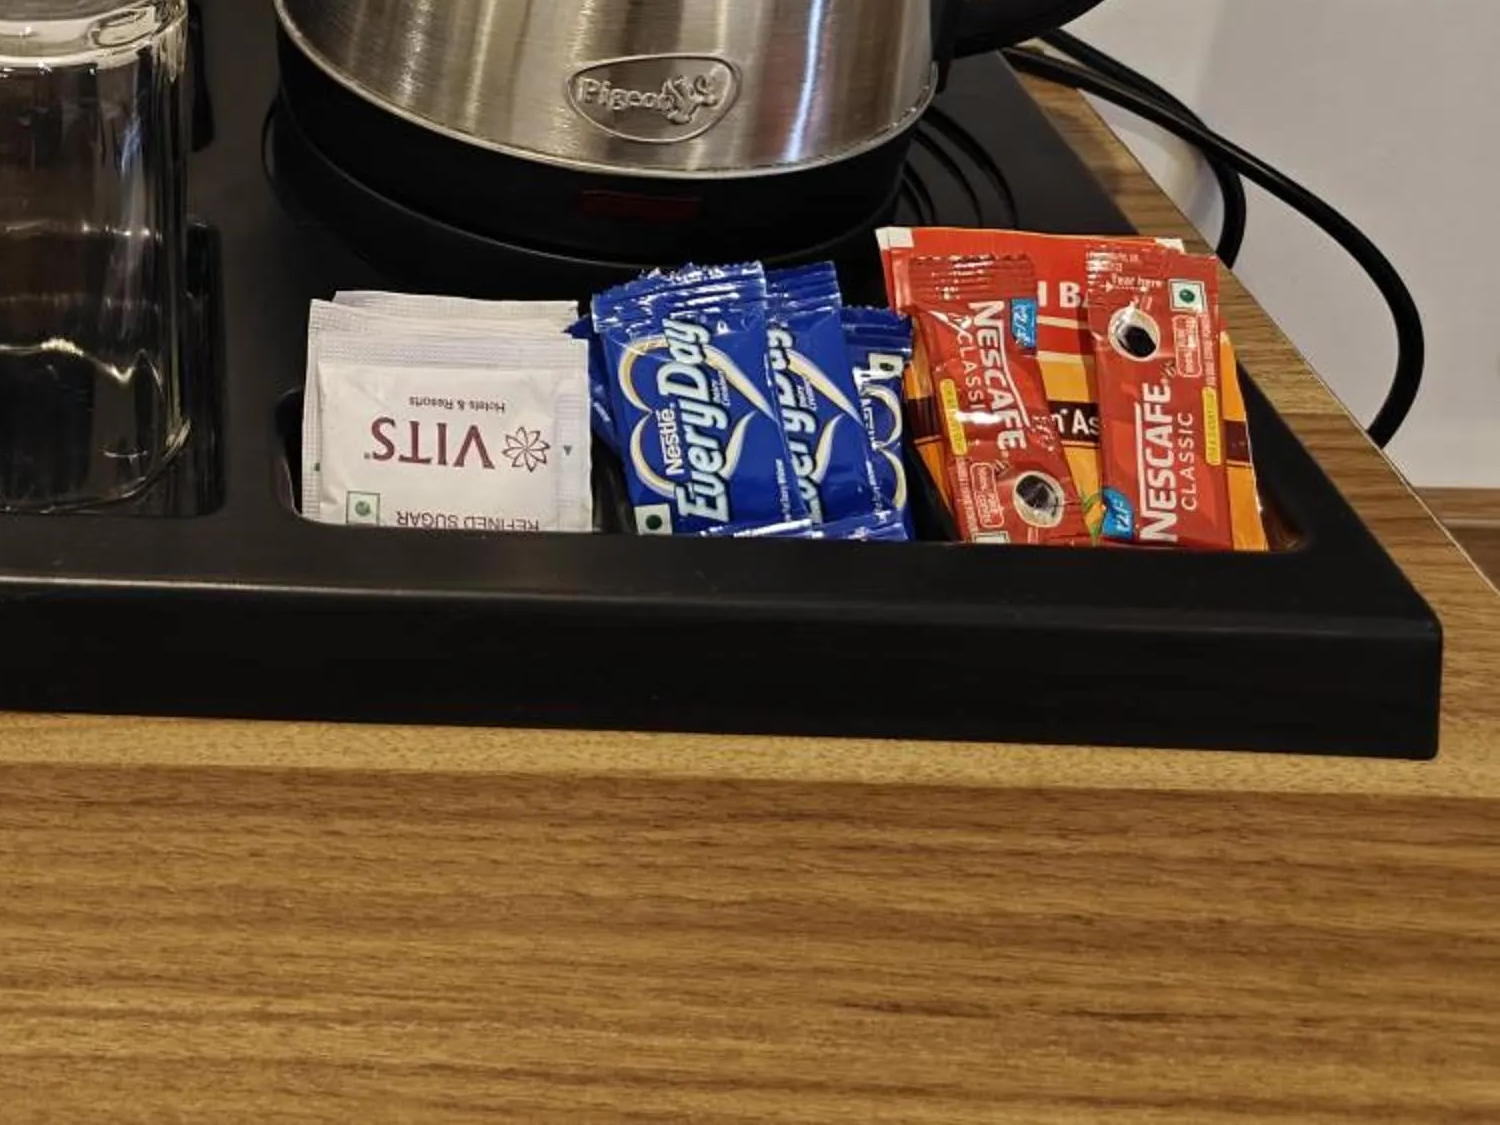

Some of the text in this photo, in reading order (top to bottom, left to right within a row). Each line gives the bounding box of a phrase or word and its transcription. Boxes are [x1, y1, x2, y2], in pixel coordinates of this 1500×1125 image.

[409, 396, 505, 413] Hotels & Resorts
[1180, 411, 1197, 512] CLASSIC
[396, 509, 458, 531] SUGAR
